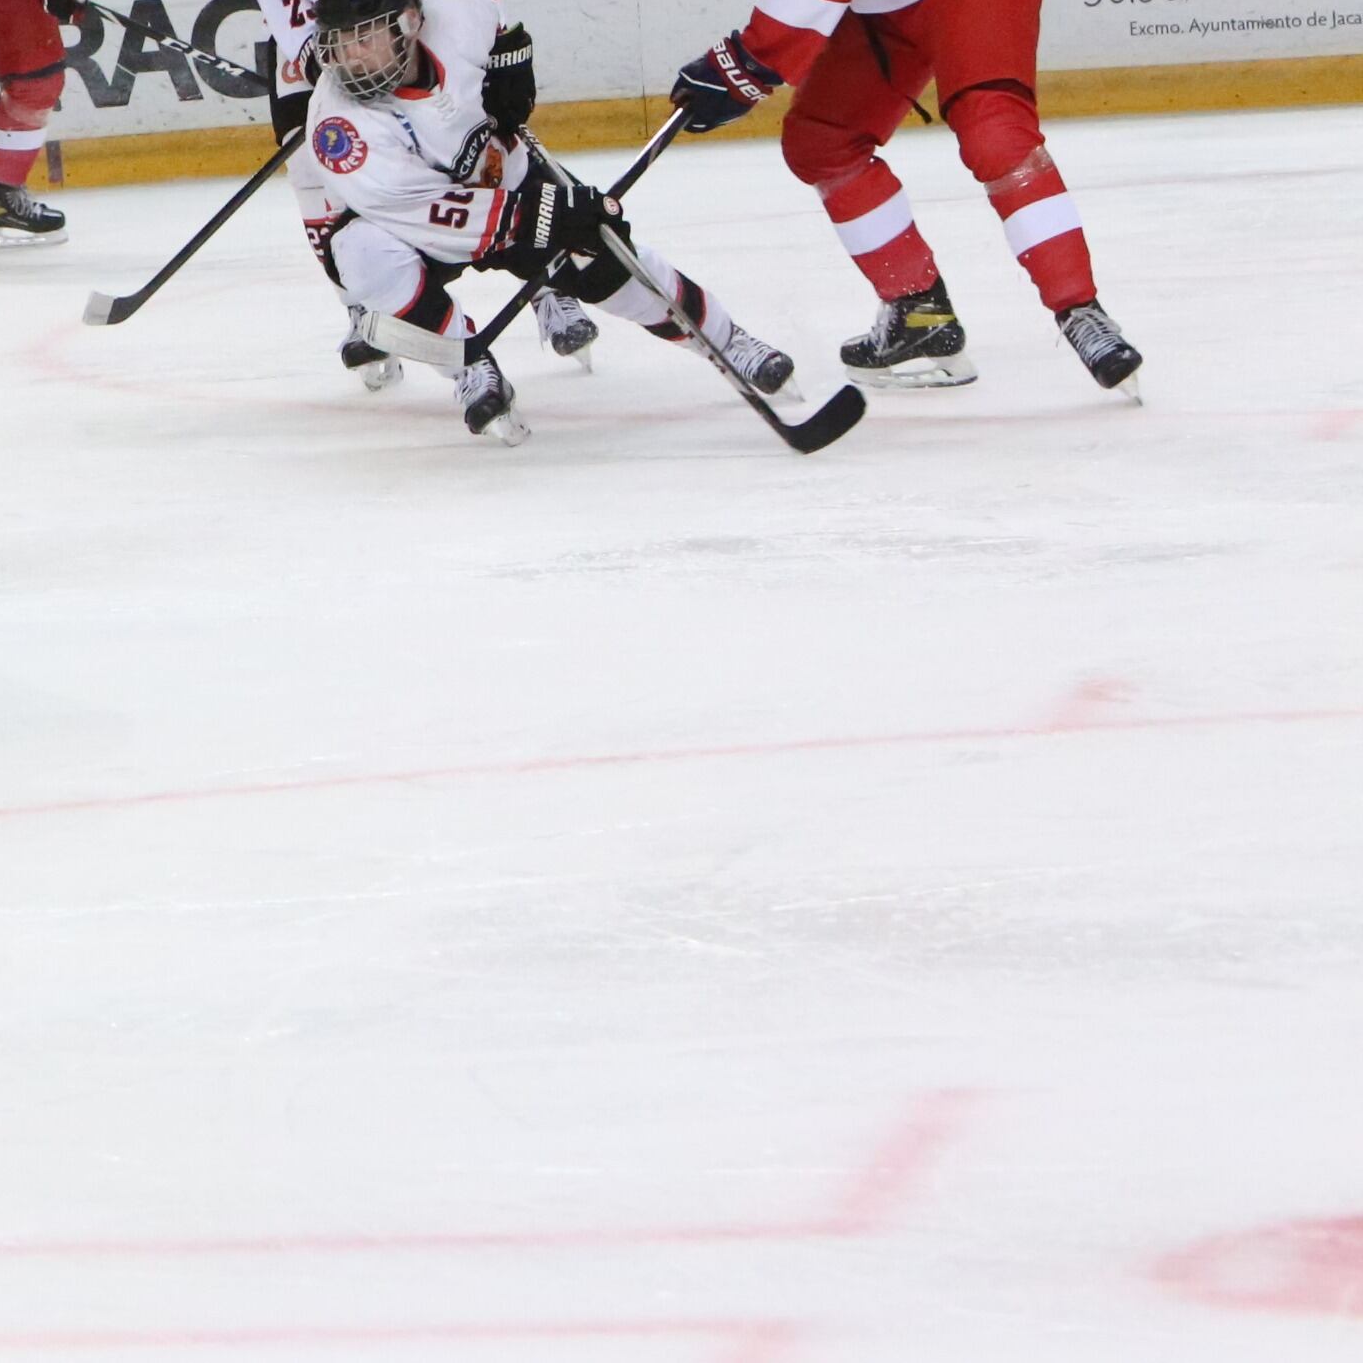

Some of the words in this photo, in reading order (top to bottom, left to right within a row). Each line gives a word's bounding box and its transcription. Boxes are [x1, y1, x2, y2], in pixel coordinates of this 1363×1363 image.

[1130, 20, 1184, 36] Excmo.
[1189, 11, 1302, 36] Ayuntamiento
[1307, 9, 1328, 26] de
[1331, 8, 1362, 31] Jaca
